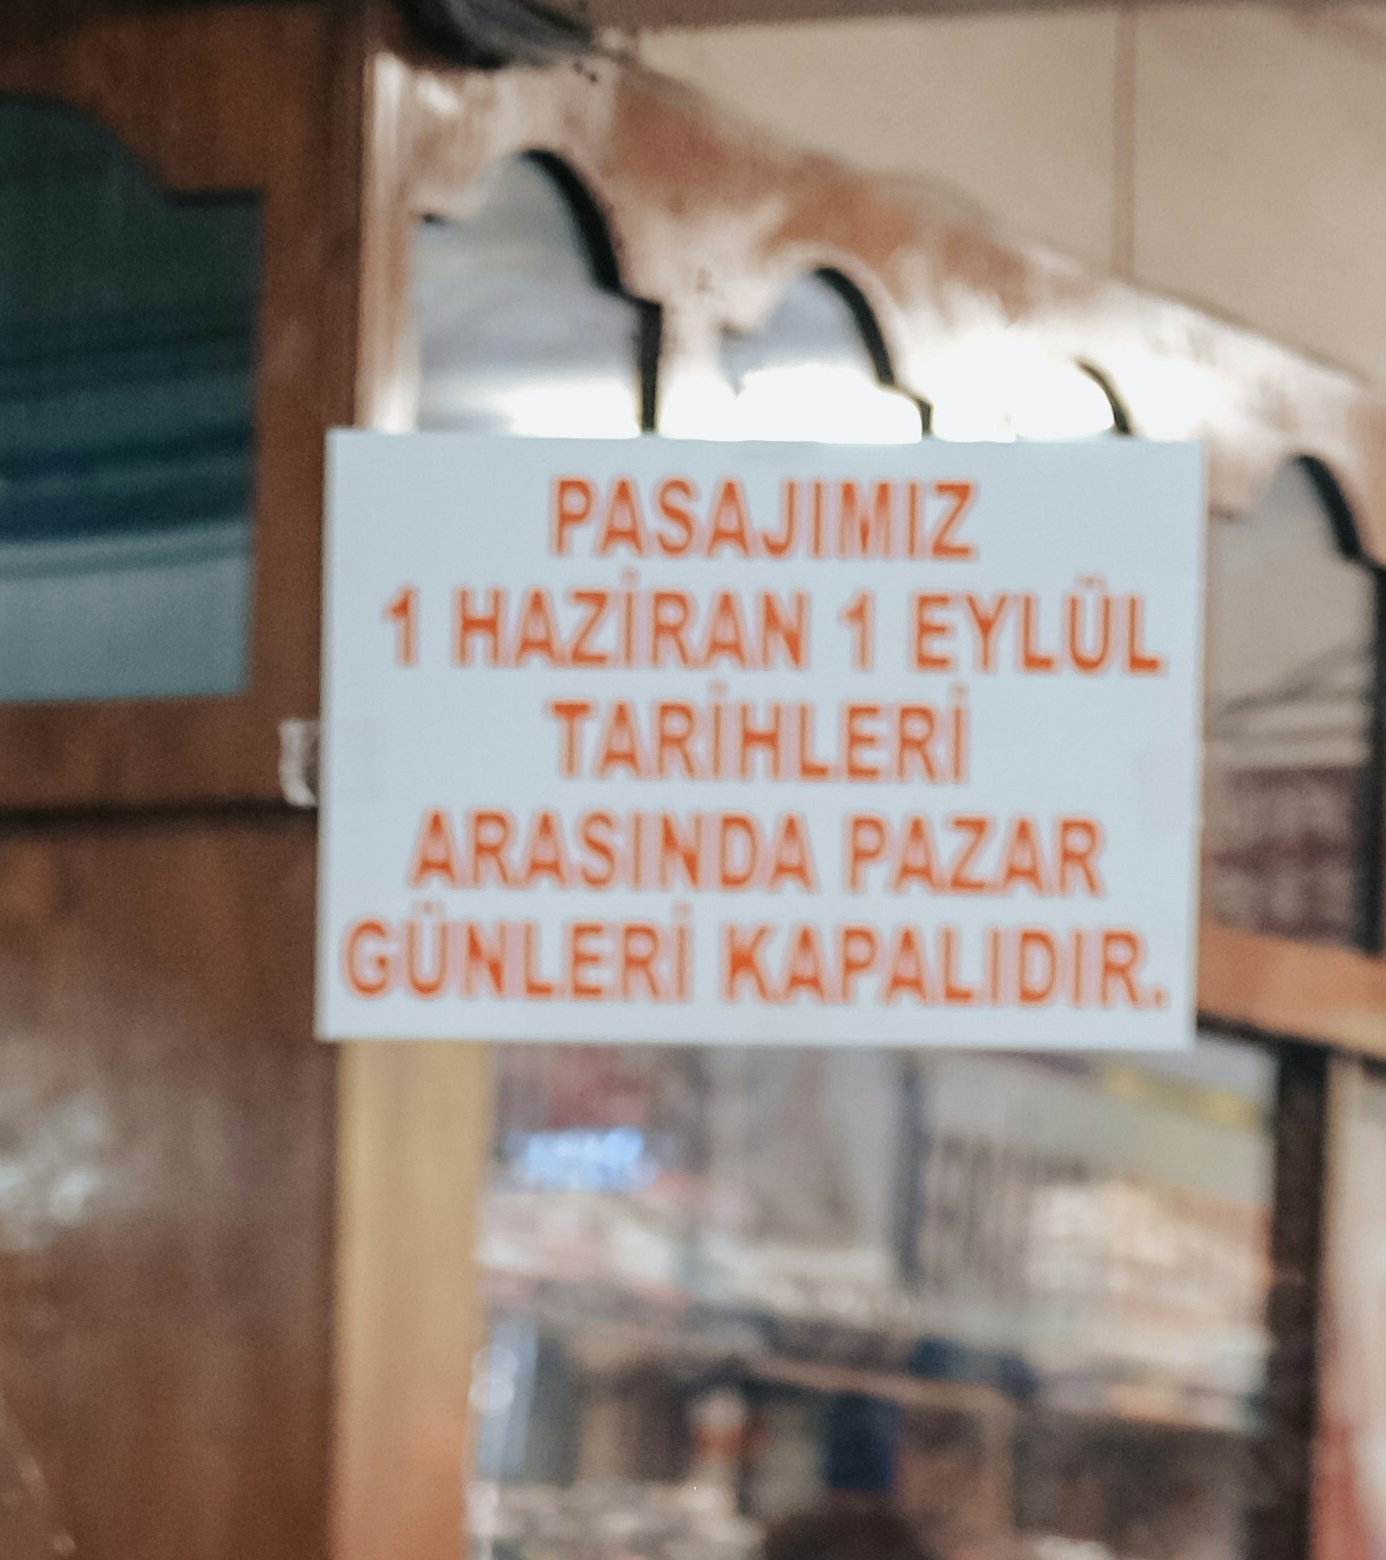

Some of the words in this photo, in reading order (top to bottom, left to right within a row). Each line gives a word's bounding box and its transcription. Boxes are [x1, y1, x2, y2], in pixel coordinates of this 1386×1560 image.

[551, 477, 978, 560] PASAJIMIZ
[384, 588, 419, 668] 1
[454, 570, 808, 673] HAZİRAN
[841, 591, 875, 671] 1
[913, 578, 1165, 675] EYLÜL
[548, 683, 970, 783] TARİHLERİ
[411, 810, 814, 891] ARASINDA
[847, 814, 1105, 898] PAZAR
[343, 902, 693, 1002] GÜNLERİ
[724, 922, 1169, 1012] KAPALIDIR.
